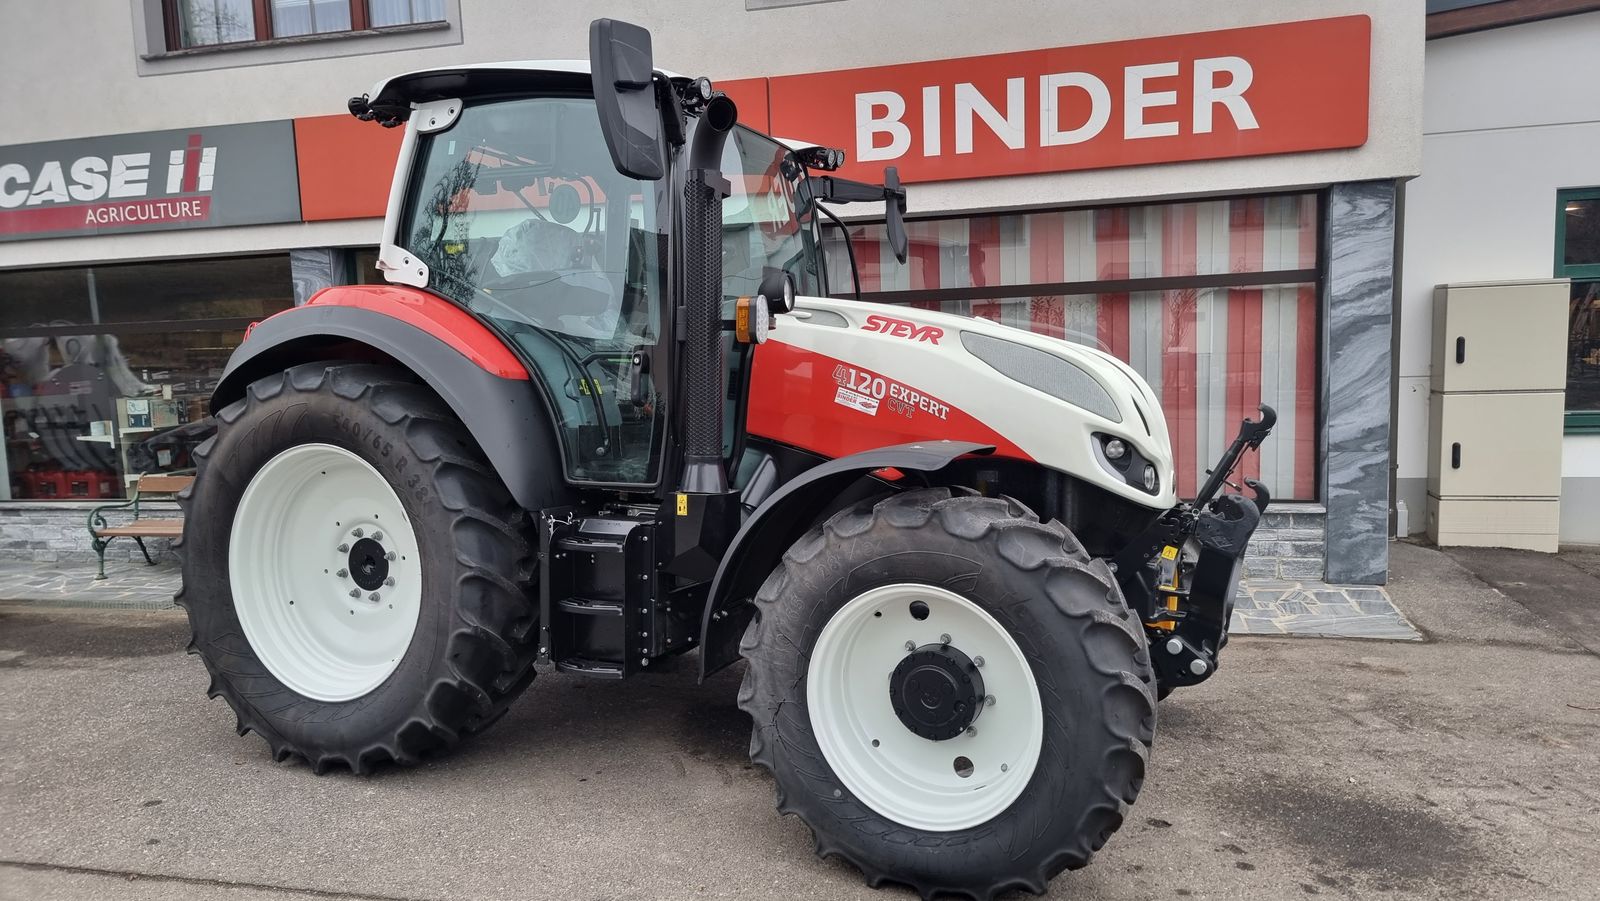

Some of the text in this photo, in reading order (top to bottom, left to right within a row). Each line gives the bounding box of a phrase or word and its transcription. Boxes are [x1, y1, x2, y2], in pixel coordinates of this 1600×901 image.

[855, 56, 1260, 163] BINDER
[0, 152, 151, 208] CASE
[85, 200, 202, 224] AGRICULTURE
[861, 314, 945, 346] STEYR
[832, 364, 887, 400] 4120
[889, 383, 950, 421] EXPERT
[887, 397, 917, 419] CVT
